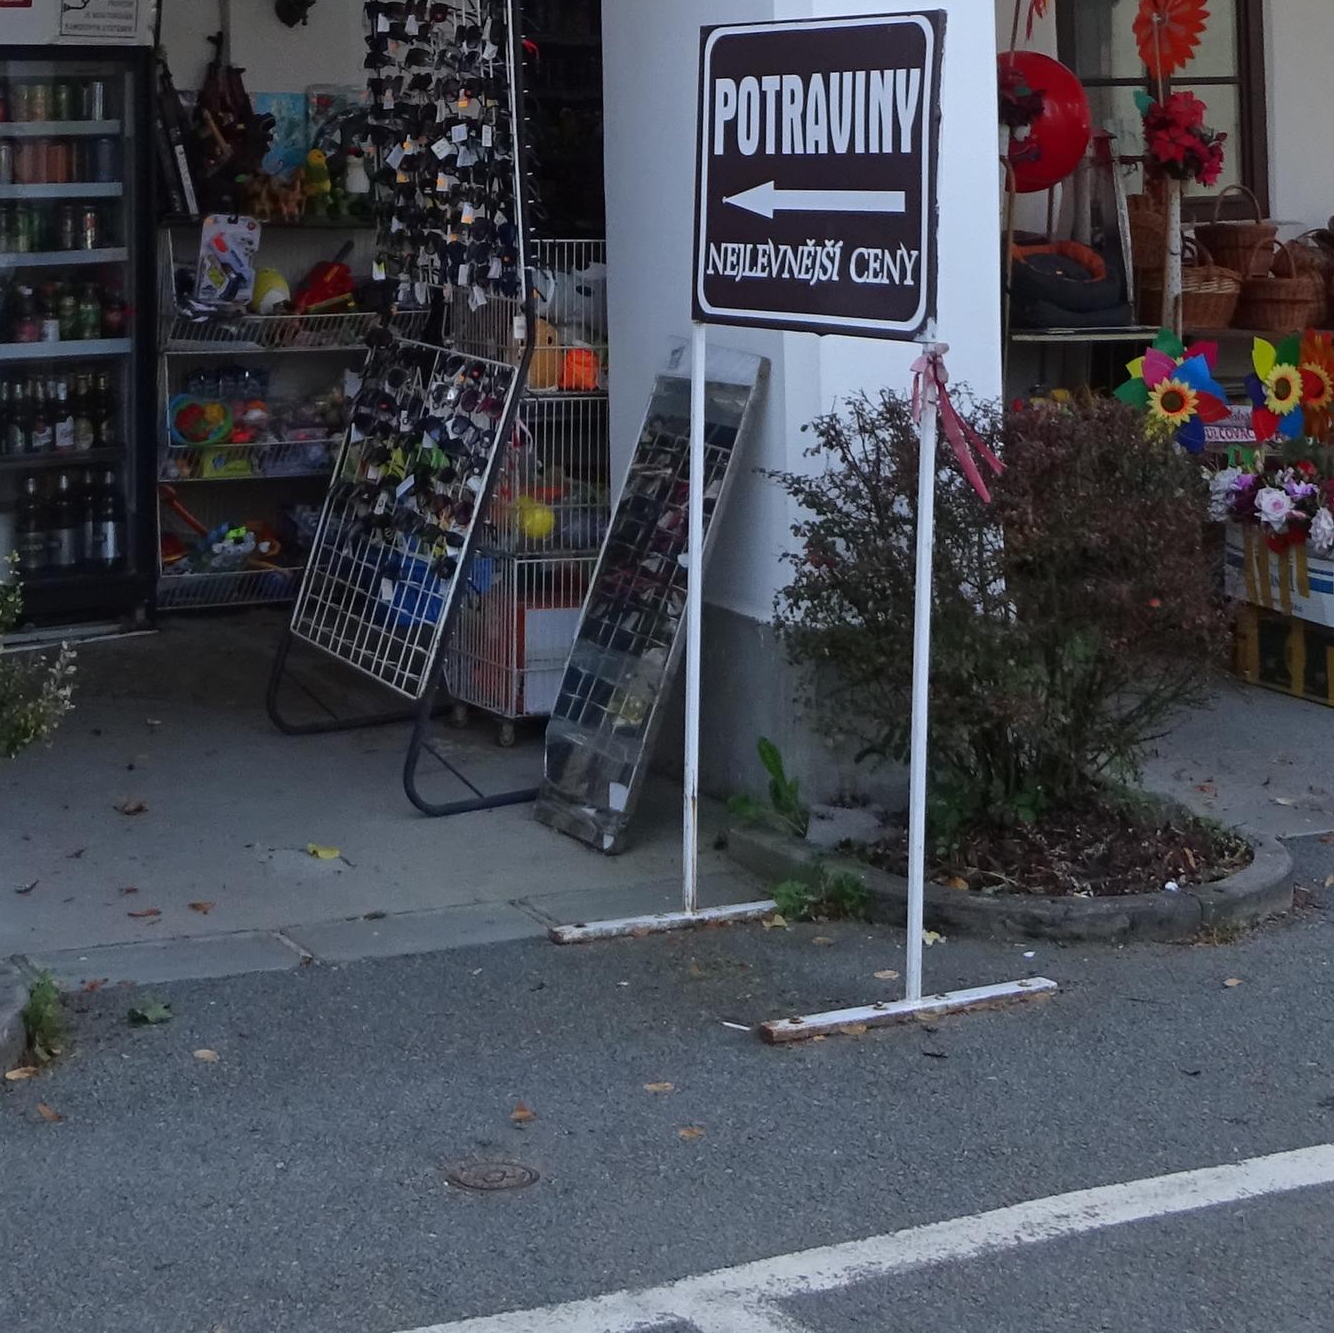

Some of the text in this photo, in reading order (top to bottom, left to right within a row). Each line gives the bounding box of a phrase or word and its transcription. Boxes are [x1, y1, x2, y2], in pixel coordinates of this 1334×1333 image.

[714, 68, 922, 155] POTRAVINY
[706, 238, 919, 286] NEJLEVNĚJŠÍ CENY
